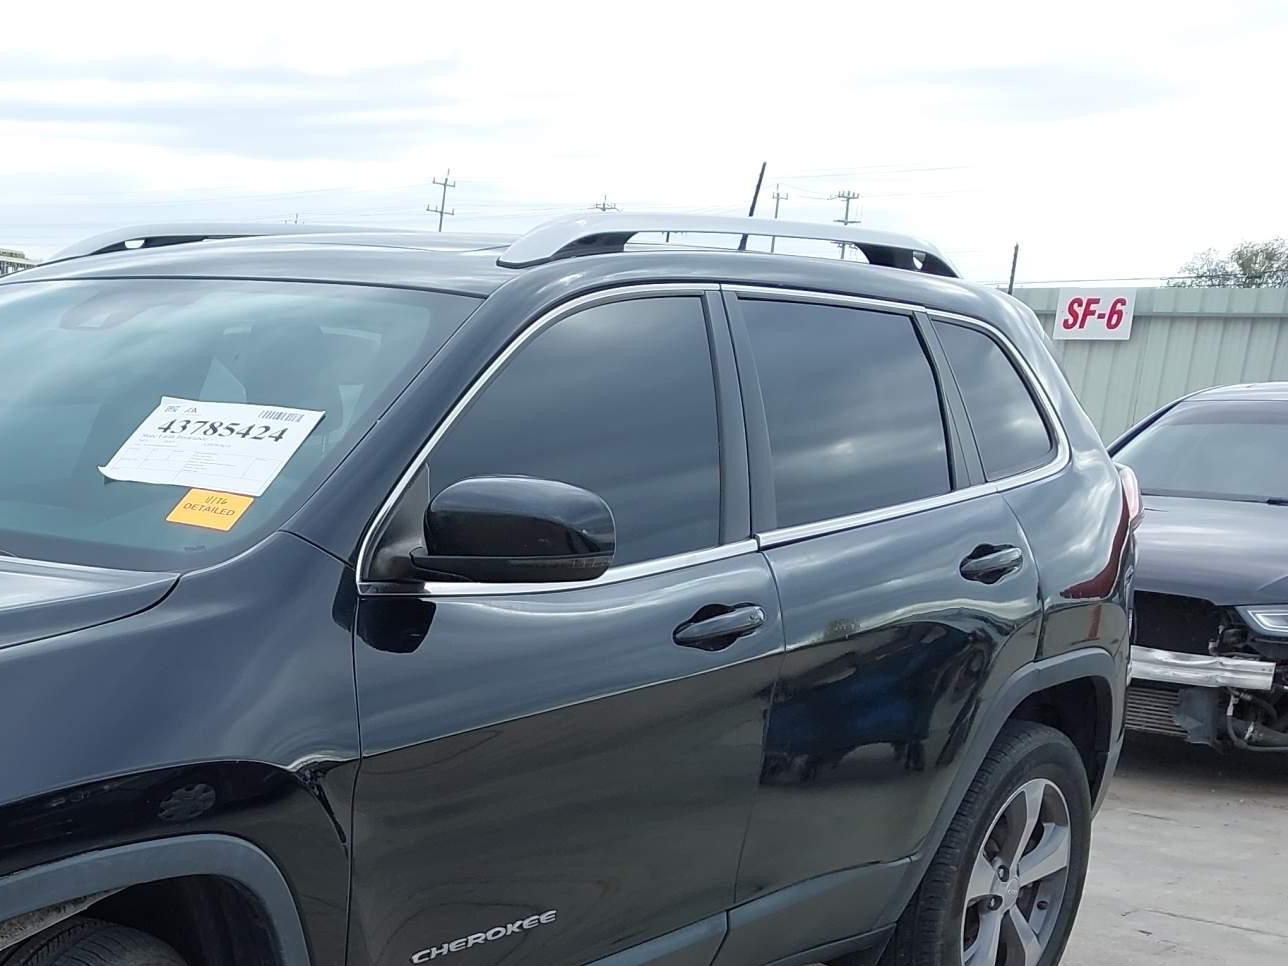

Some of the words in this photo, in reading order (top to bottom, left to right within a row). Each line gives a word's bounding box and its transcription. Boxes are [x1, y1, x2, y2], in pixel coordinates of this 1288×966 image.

[1062, 297, 1127, 330] SF-6
[157, 418, 289, 442] 43785424
[183, 502, 236, 516] DETAILED
[411, 910, 558, 965] CHEROKEE
